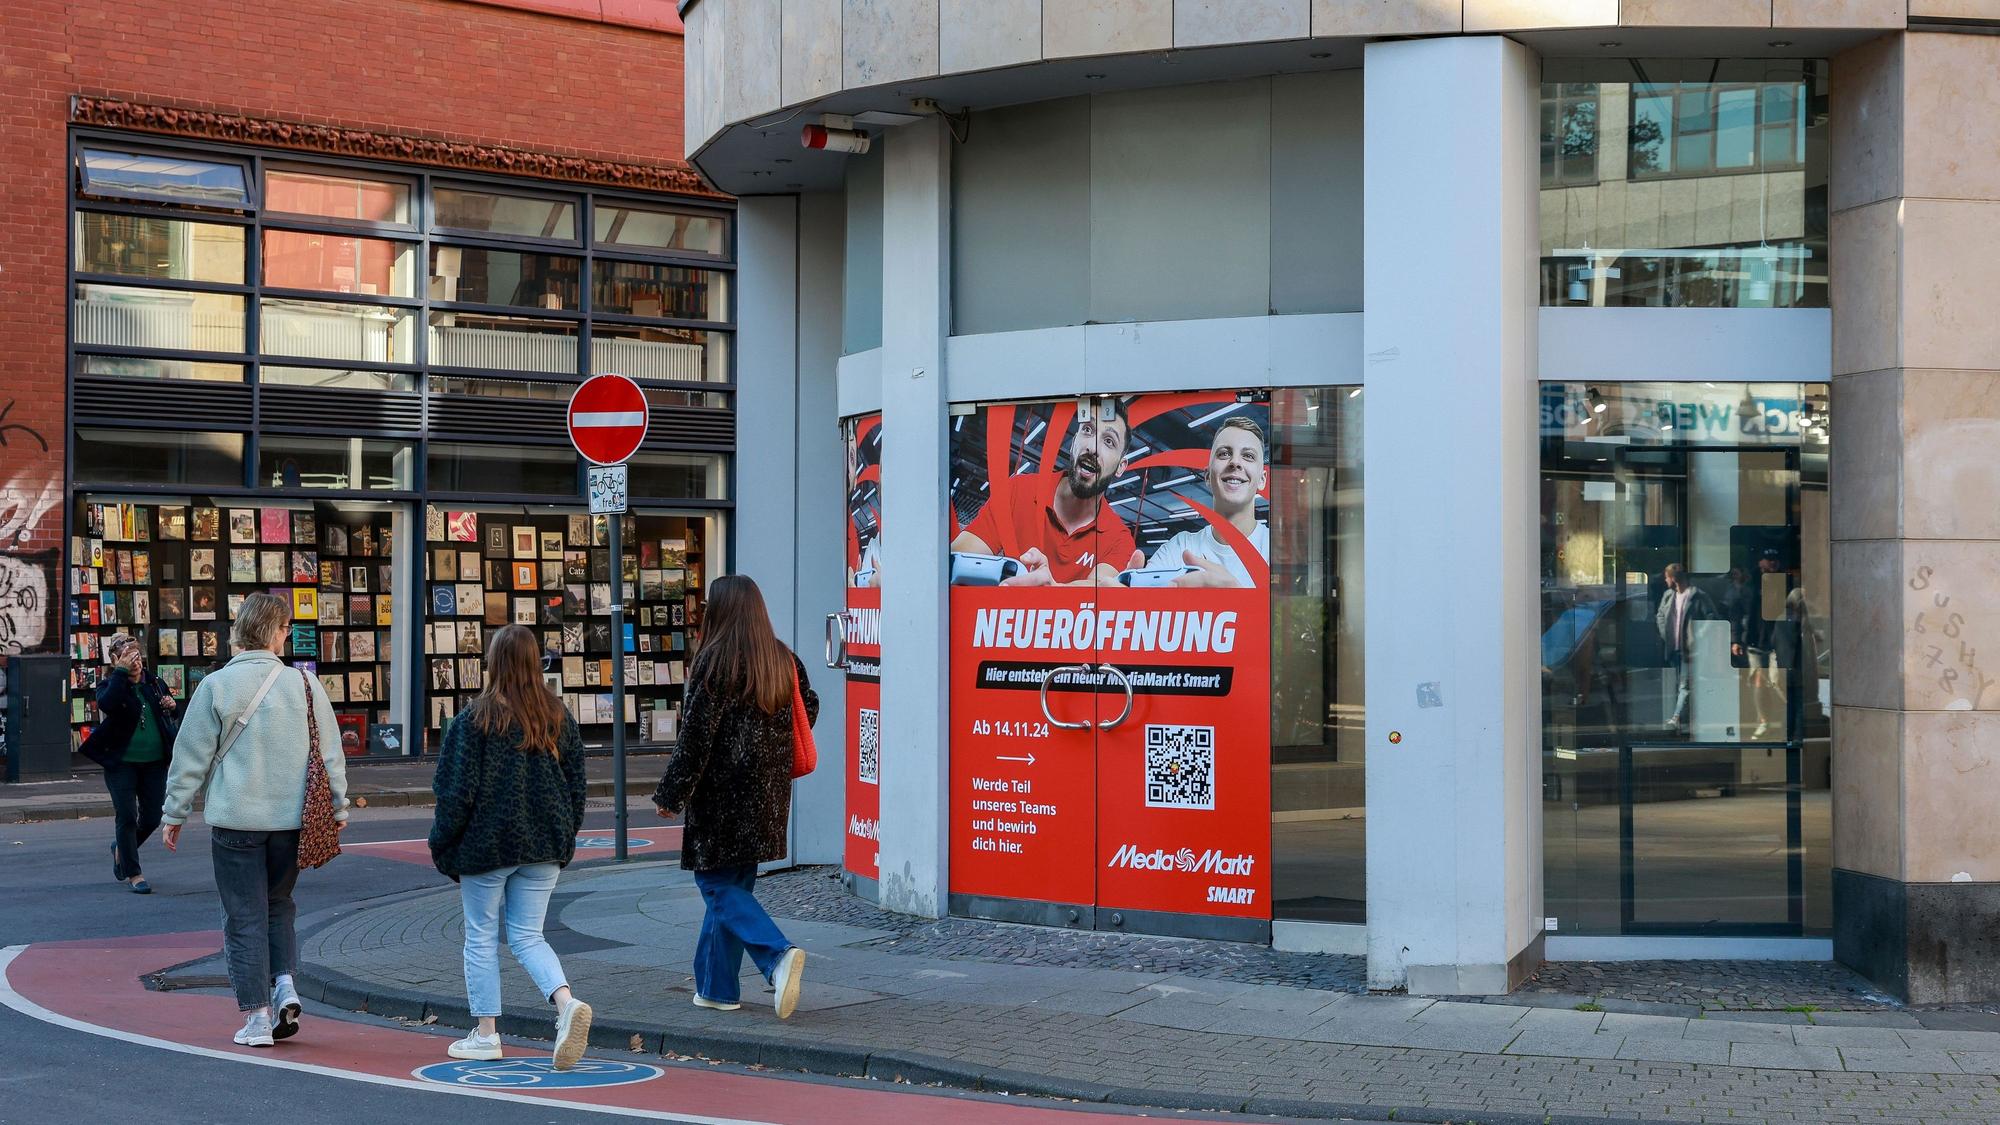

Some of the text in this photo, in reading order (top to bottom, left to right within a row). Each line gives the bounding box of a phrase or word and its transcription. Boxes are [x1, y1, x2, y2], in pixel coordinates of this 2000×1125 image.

[848, 607, 881, 645] FFNUN
[973, 603, 1237, 653] NEUERÖFFNUNG
[986, 667, 1007, 682] Hier
[1008, 668, 1052, 683] entsteh
[1072, 672, 1106, 685] neuer
[1183, 673, 1220, 688] Smart
[973, 720, 1049, 737] Ab 14.11.24
[972, 778, 1031, 793] Werde Teil
[972, 800, 1056, 815] unseres Teams
[972, 818, 1036, 834] und bewirb
[972, 837, 1023, 853] dich hier.
[1207, 886, 1255, 904] SMART
